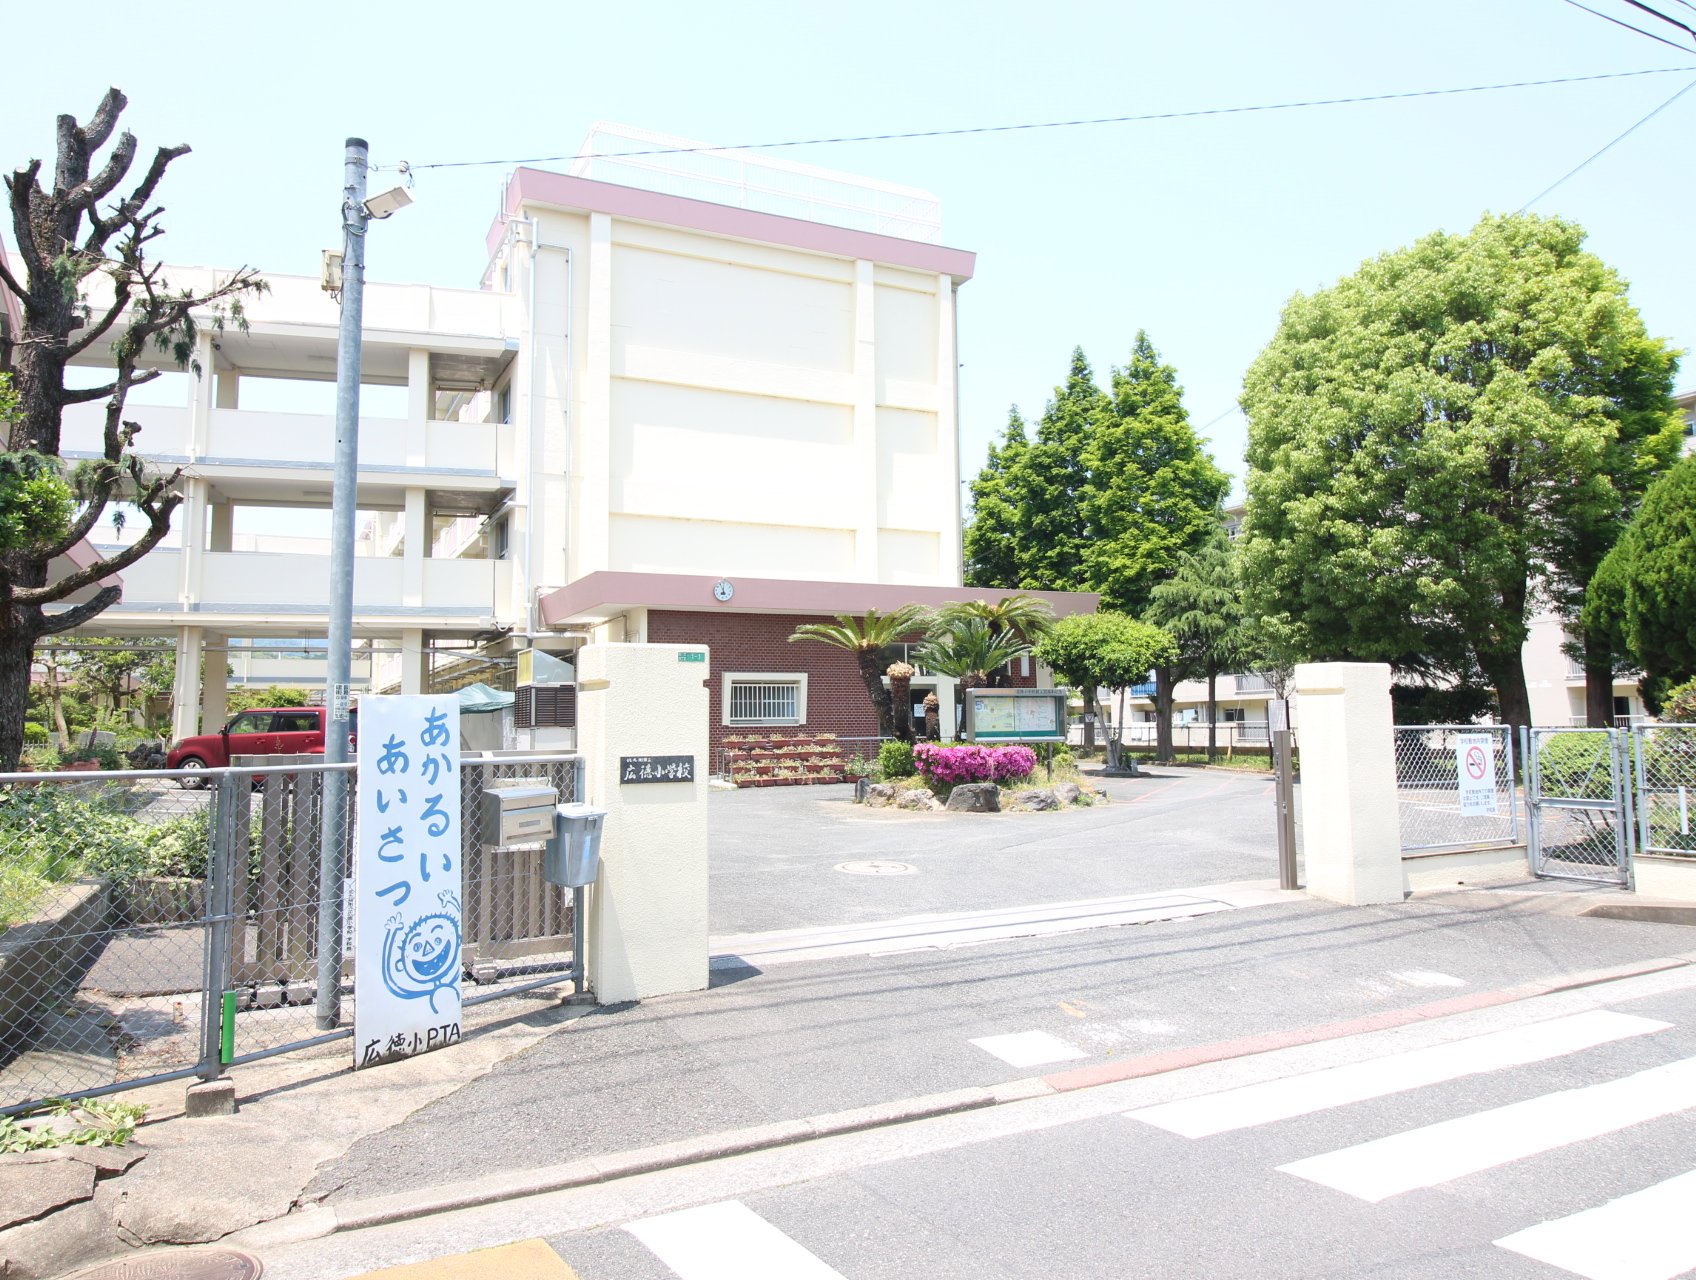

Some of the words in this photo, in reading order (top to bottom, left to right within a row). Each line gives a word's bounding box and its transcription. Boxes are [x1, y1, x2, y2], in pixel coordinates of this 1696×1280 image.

[375, 733, 411, 907] あいさつ
[419, 705, 452, 883] あかるい
[624, 762, 692, 781] 広徳小学校
[360, 1022, 461, 1066] 広徳小PTA
